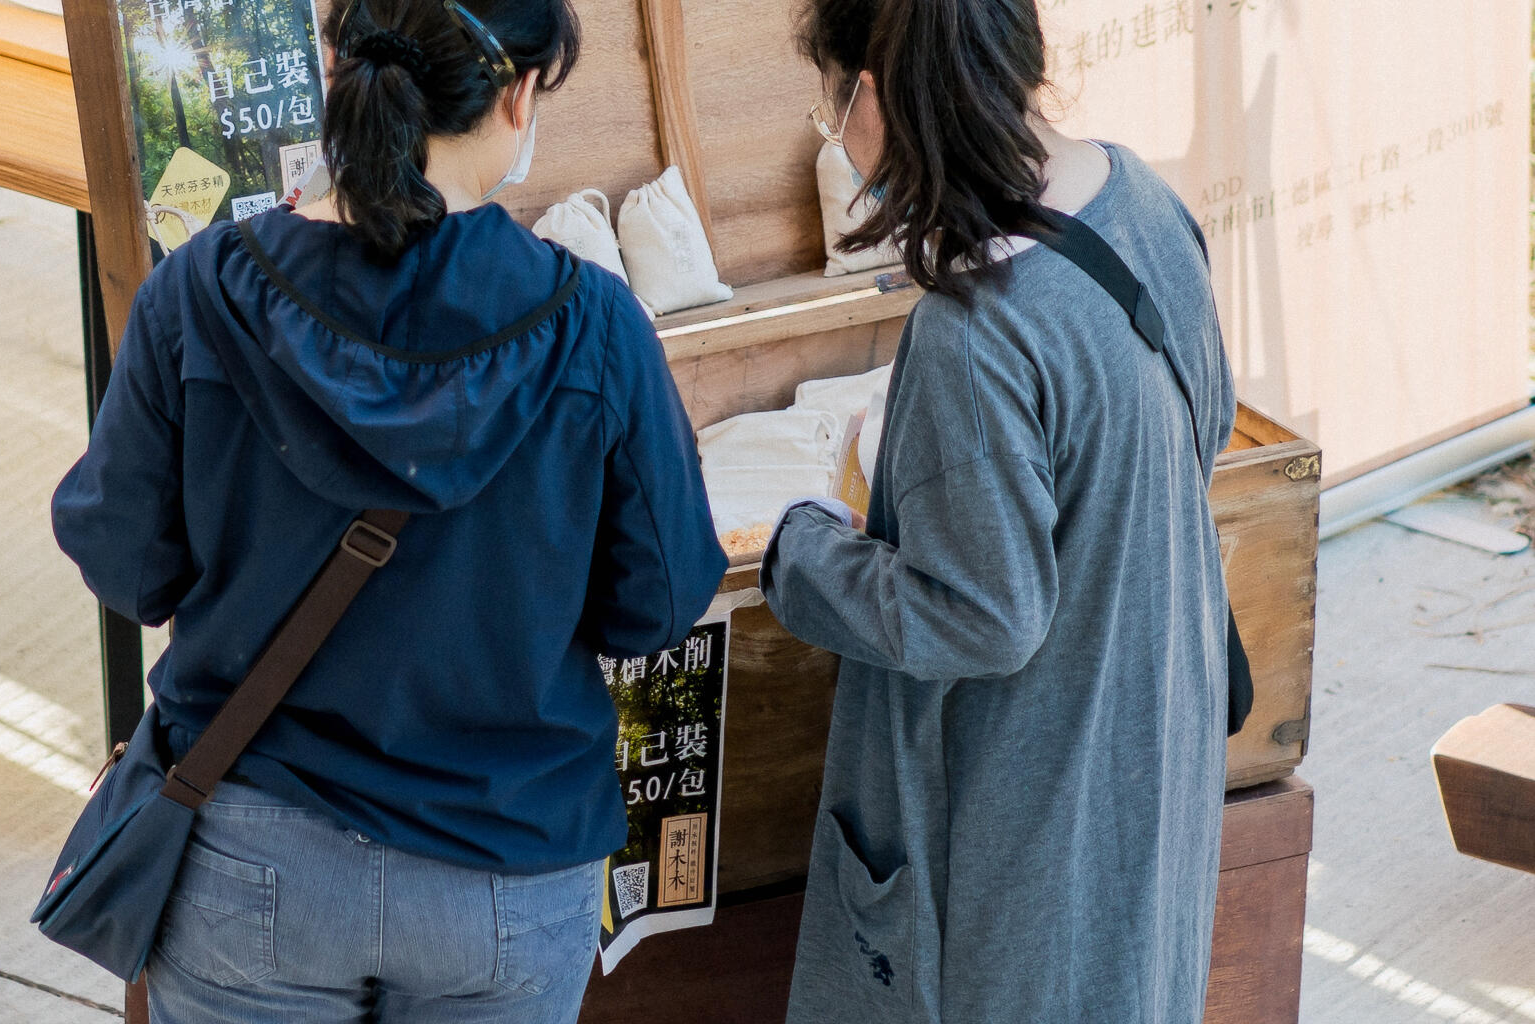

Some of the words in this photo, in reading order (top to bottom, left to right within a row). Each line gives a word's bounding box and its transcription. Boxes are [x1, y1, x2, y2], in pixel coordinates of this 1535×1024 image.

[208, 48, 311, 103] 自己裝
[219, 94, 316, 140] $50/包
[666, 828, 688, 891] 謝木木
